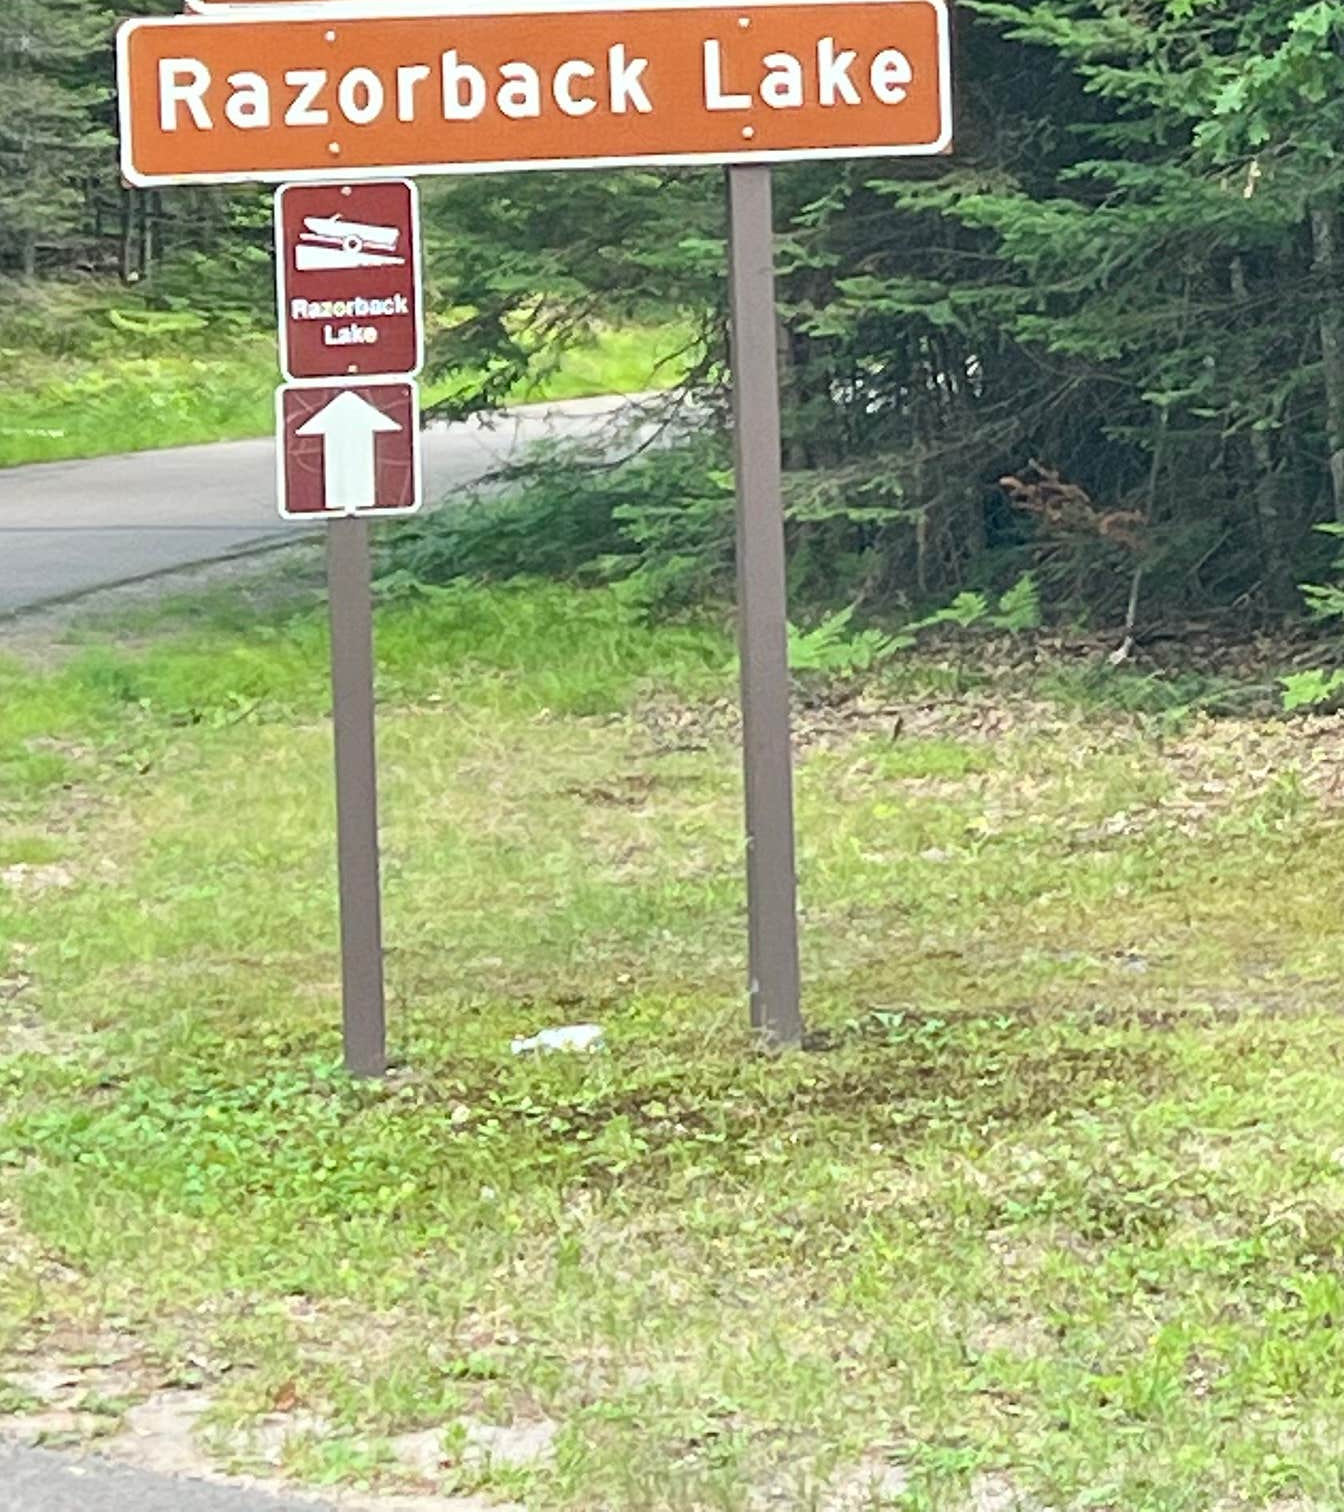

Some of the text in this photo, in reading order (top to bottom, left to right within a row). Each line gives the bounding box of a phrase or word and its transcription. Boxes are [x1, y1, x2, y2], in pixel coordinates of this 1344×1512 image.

[158, 37, 913, 132] Razorback Lake
[291, 293, 409, 320] Razorback
[324, 324, 378, 345] Lake
